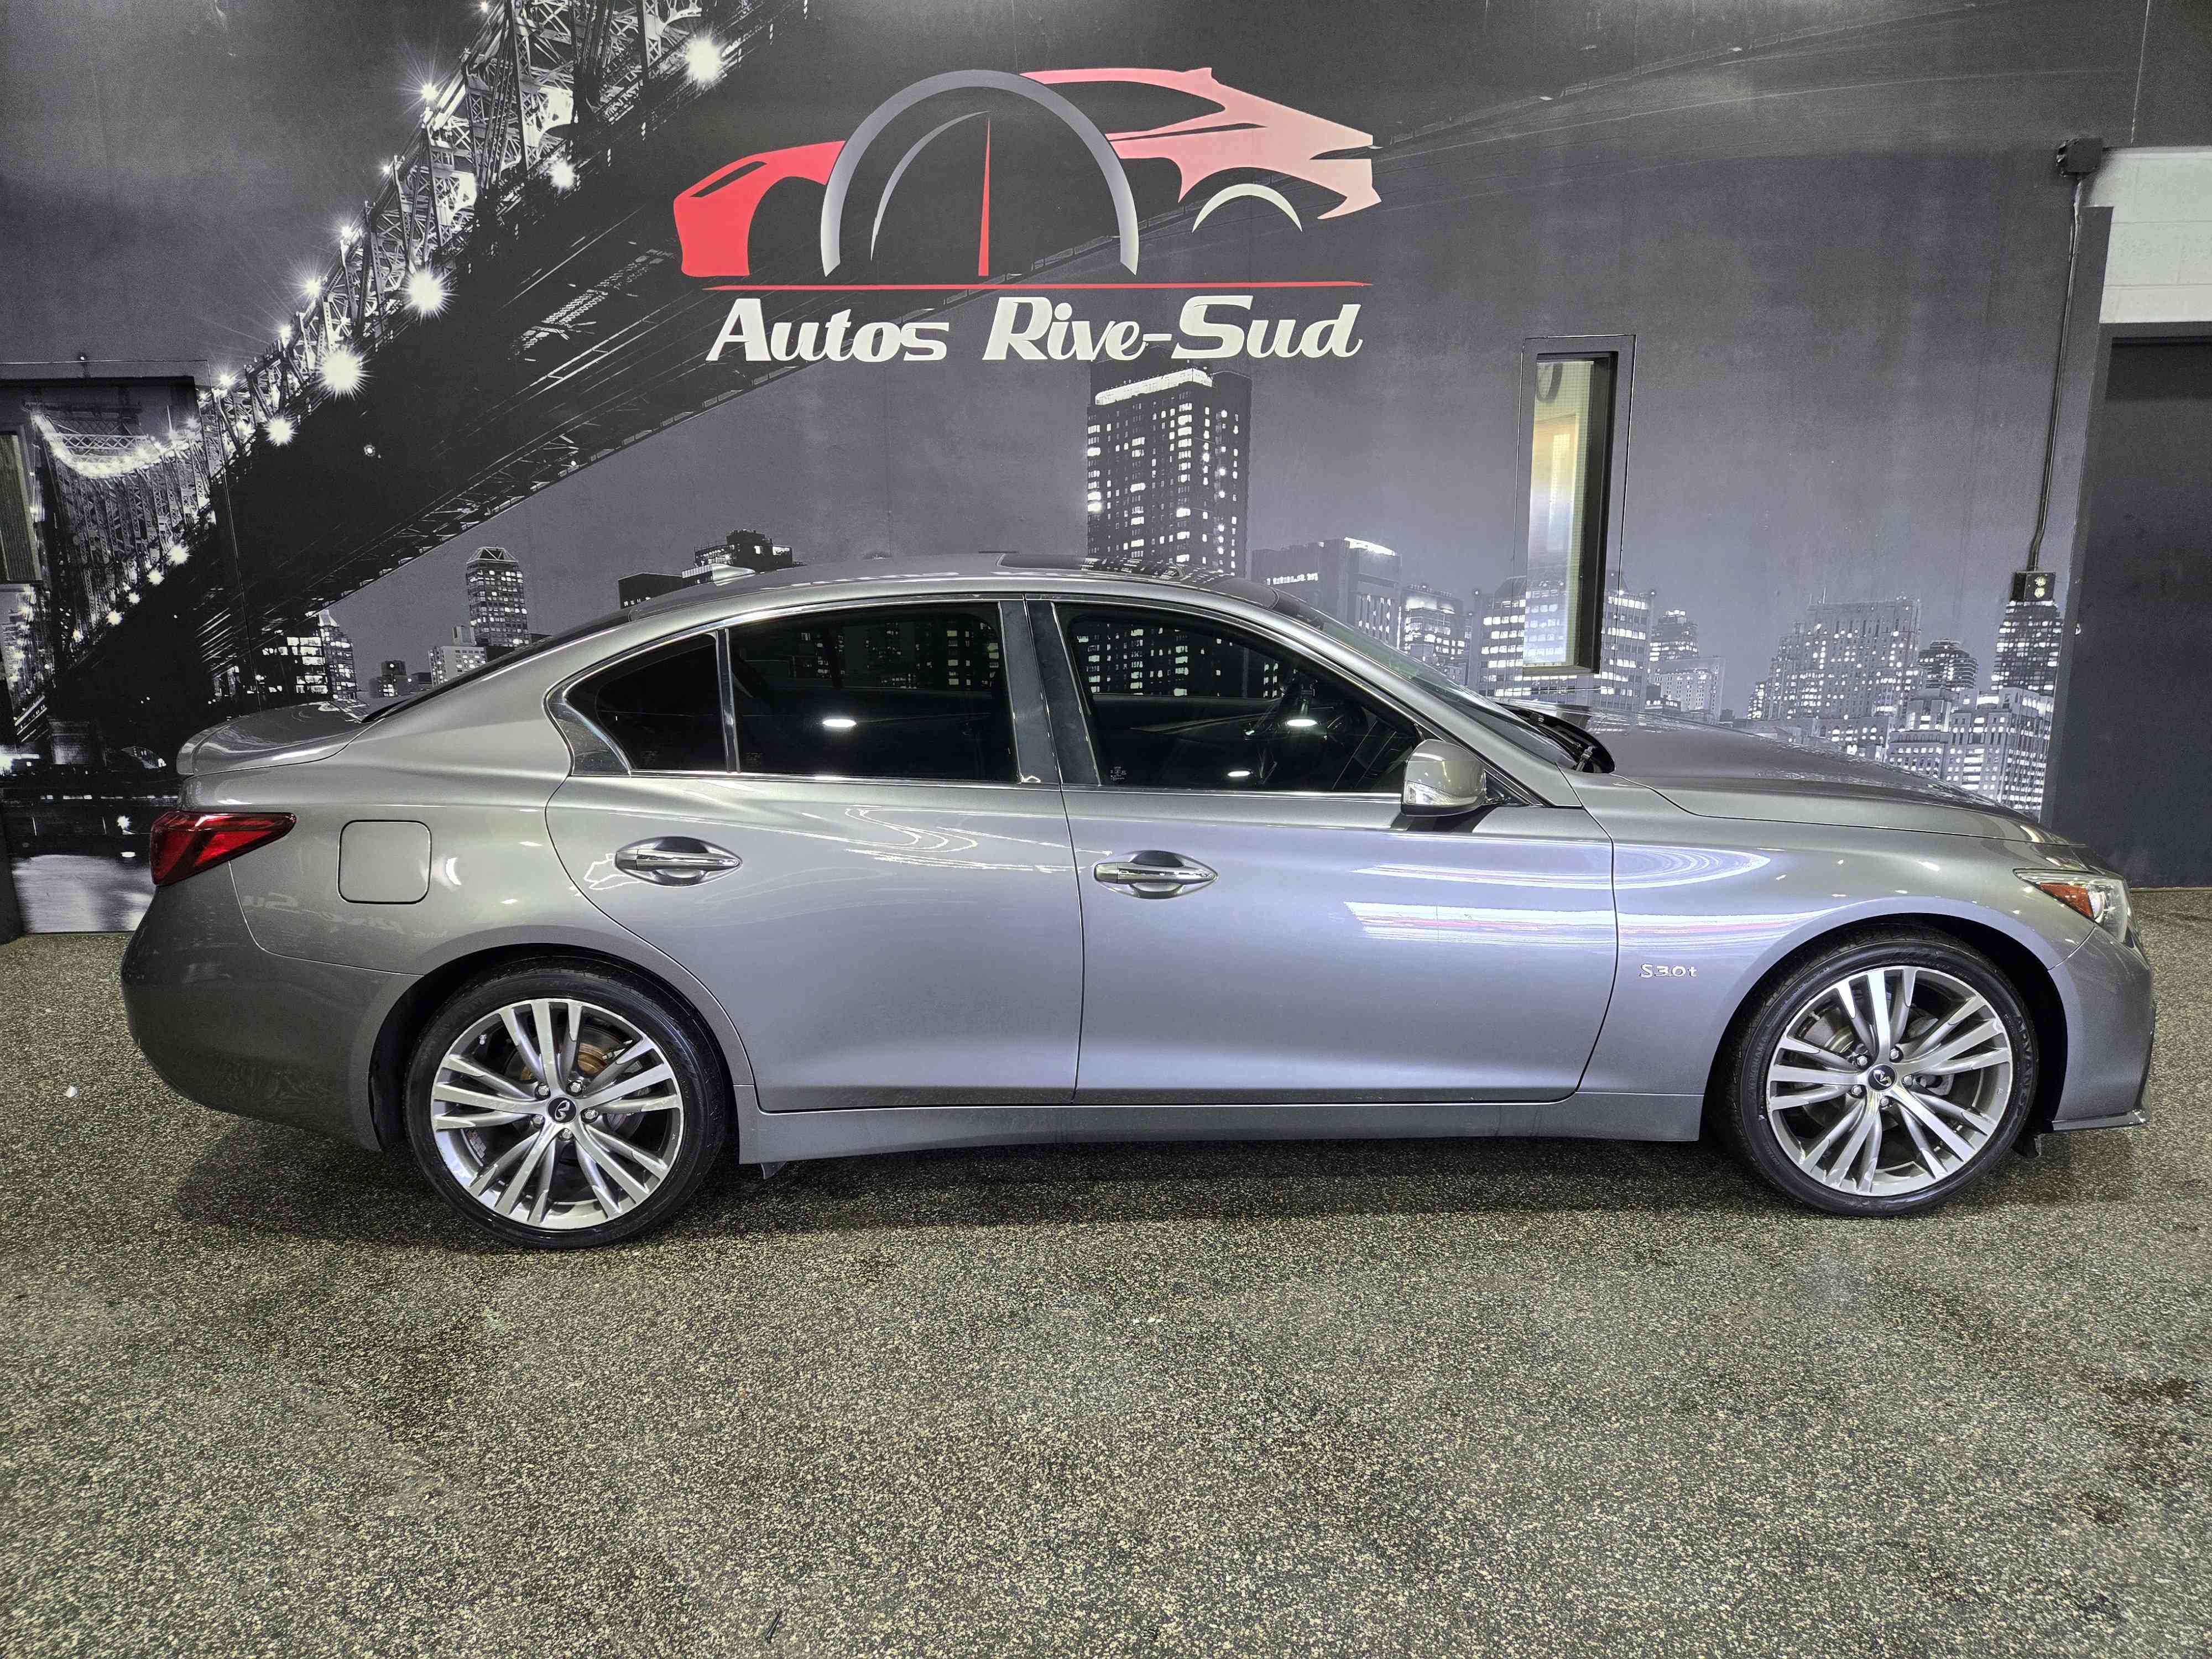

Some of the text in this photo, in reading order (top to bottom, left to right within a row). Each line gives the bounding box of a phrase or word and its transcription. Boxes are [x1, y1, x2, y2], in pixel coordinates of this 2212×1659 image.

[705, 295, 1363, 362] Autos Rive-Sud
[1747, 1036, 1770, 1091] YOKOHAMA
